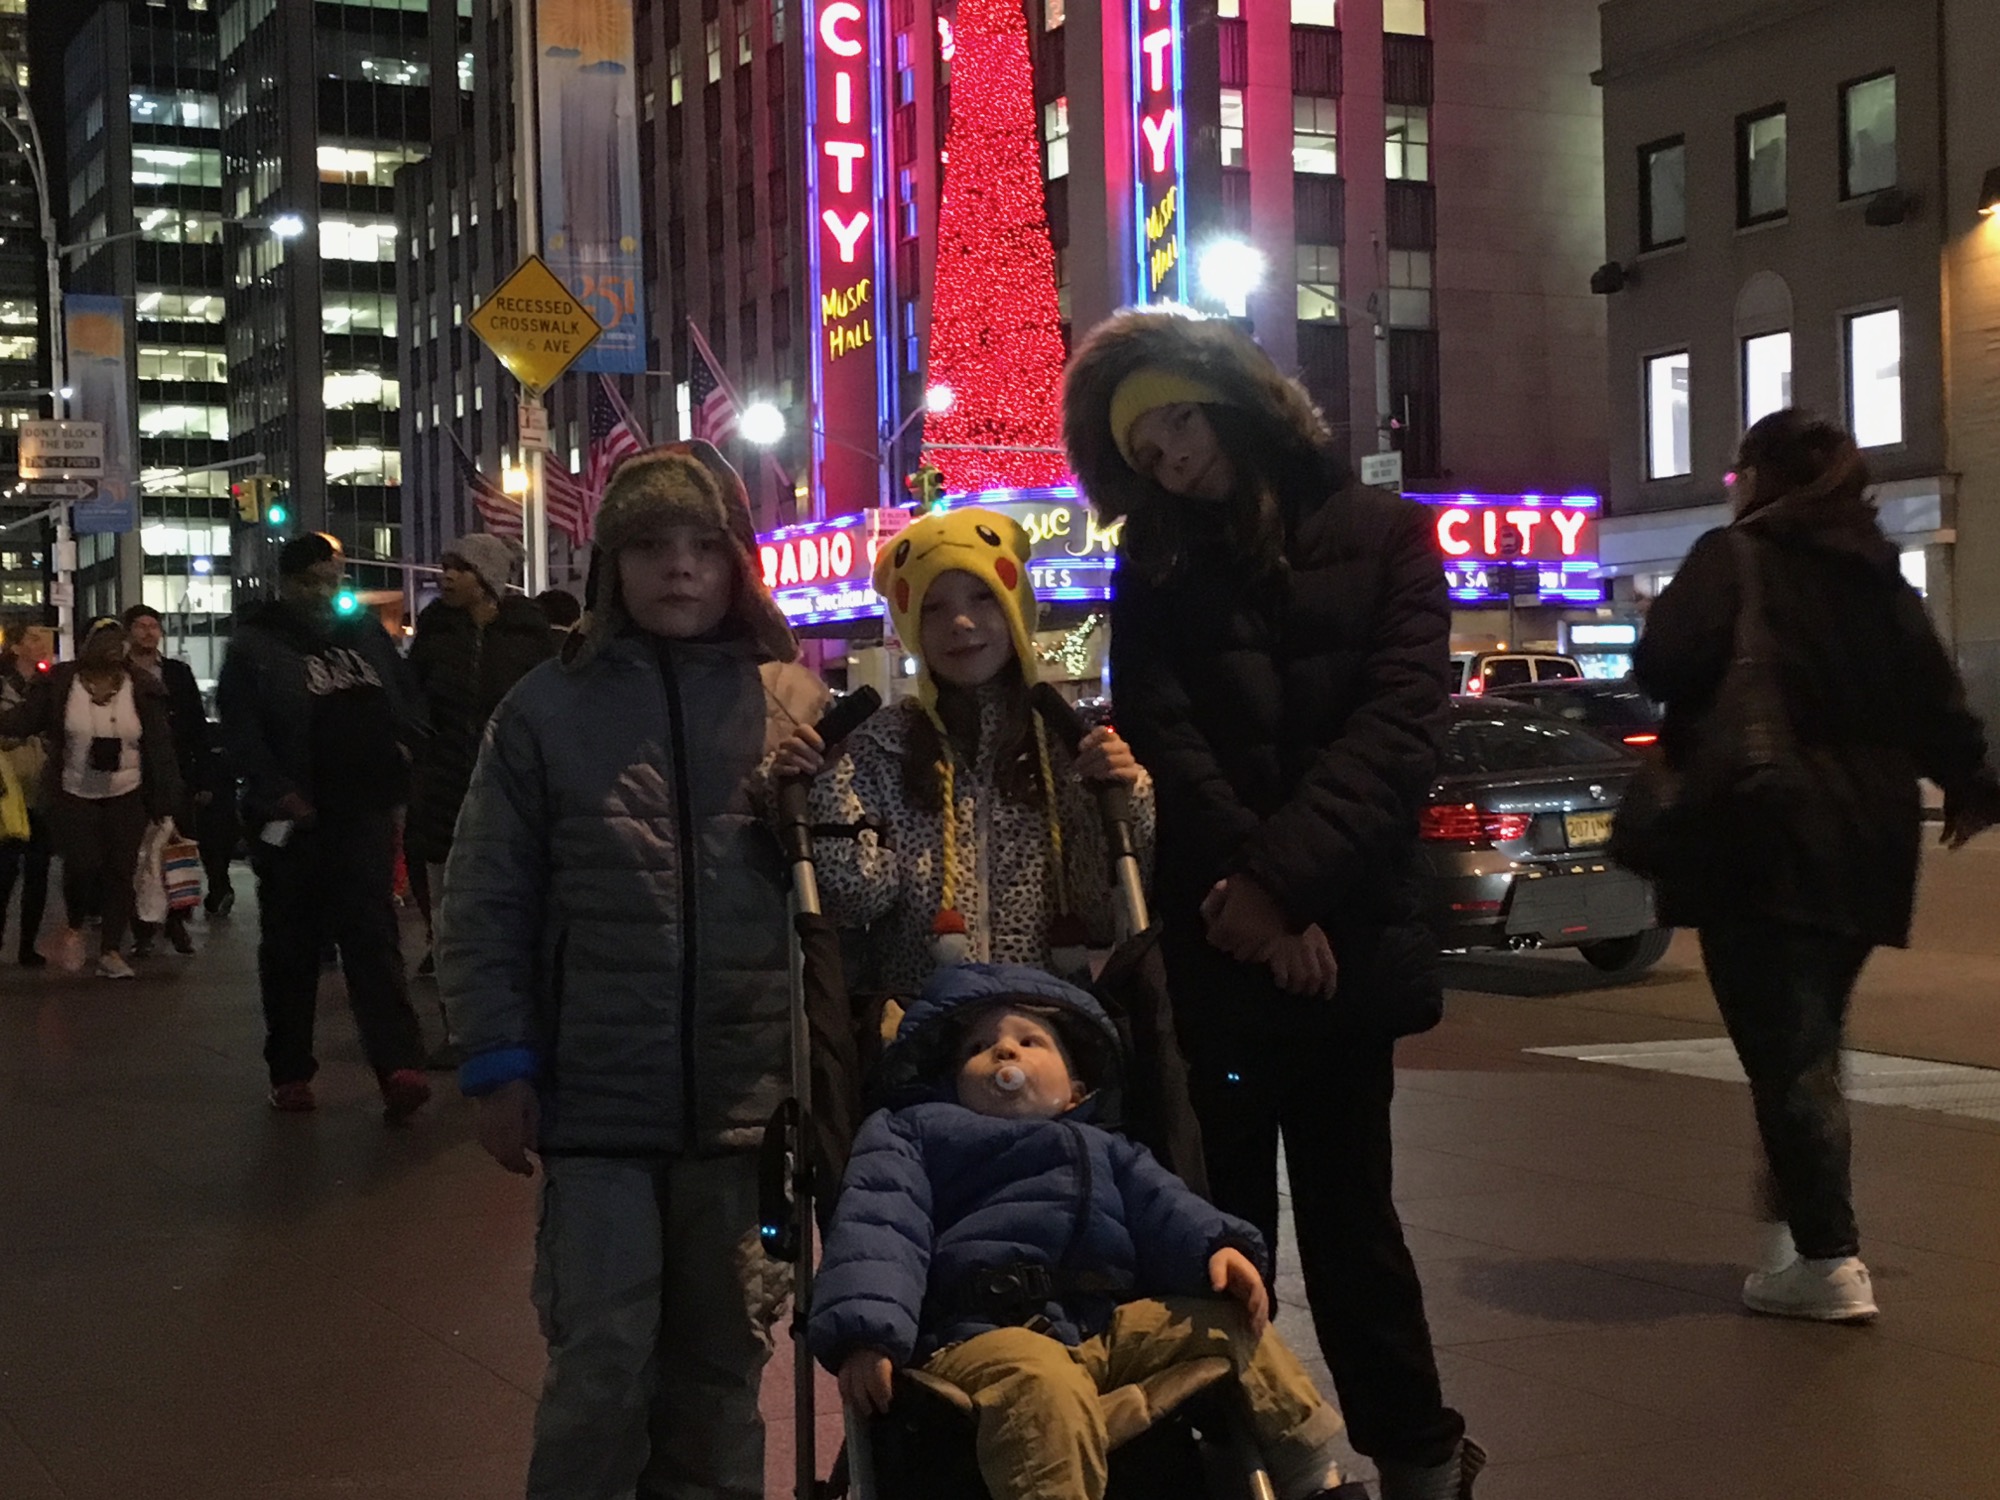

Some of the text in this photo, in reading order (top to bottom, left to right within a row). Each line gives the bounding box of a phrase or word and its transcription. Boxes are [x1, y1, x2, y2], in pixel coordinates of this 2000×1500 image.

[1143, 0, 1176, 172] TY
[820, 2, 870, 263] CITY
[496, 297, 573, 316] RECESSED
[490, 316, 580, 336] CROSSWALK
[526, 337, 537, 351] 6
[543, 339, 572, 354] AVE
[62, 428, 98, 439] BLOCK
[40, 440, 85, 450] THE BOX
[1437, 508, 1586, 555] CITY
[760, 531, 853, 588] RADIO
